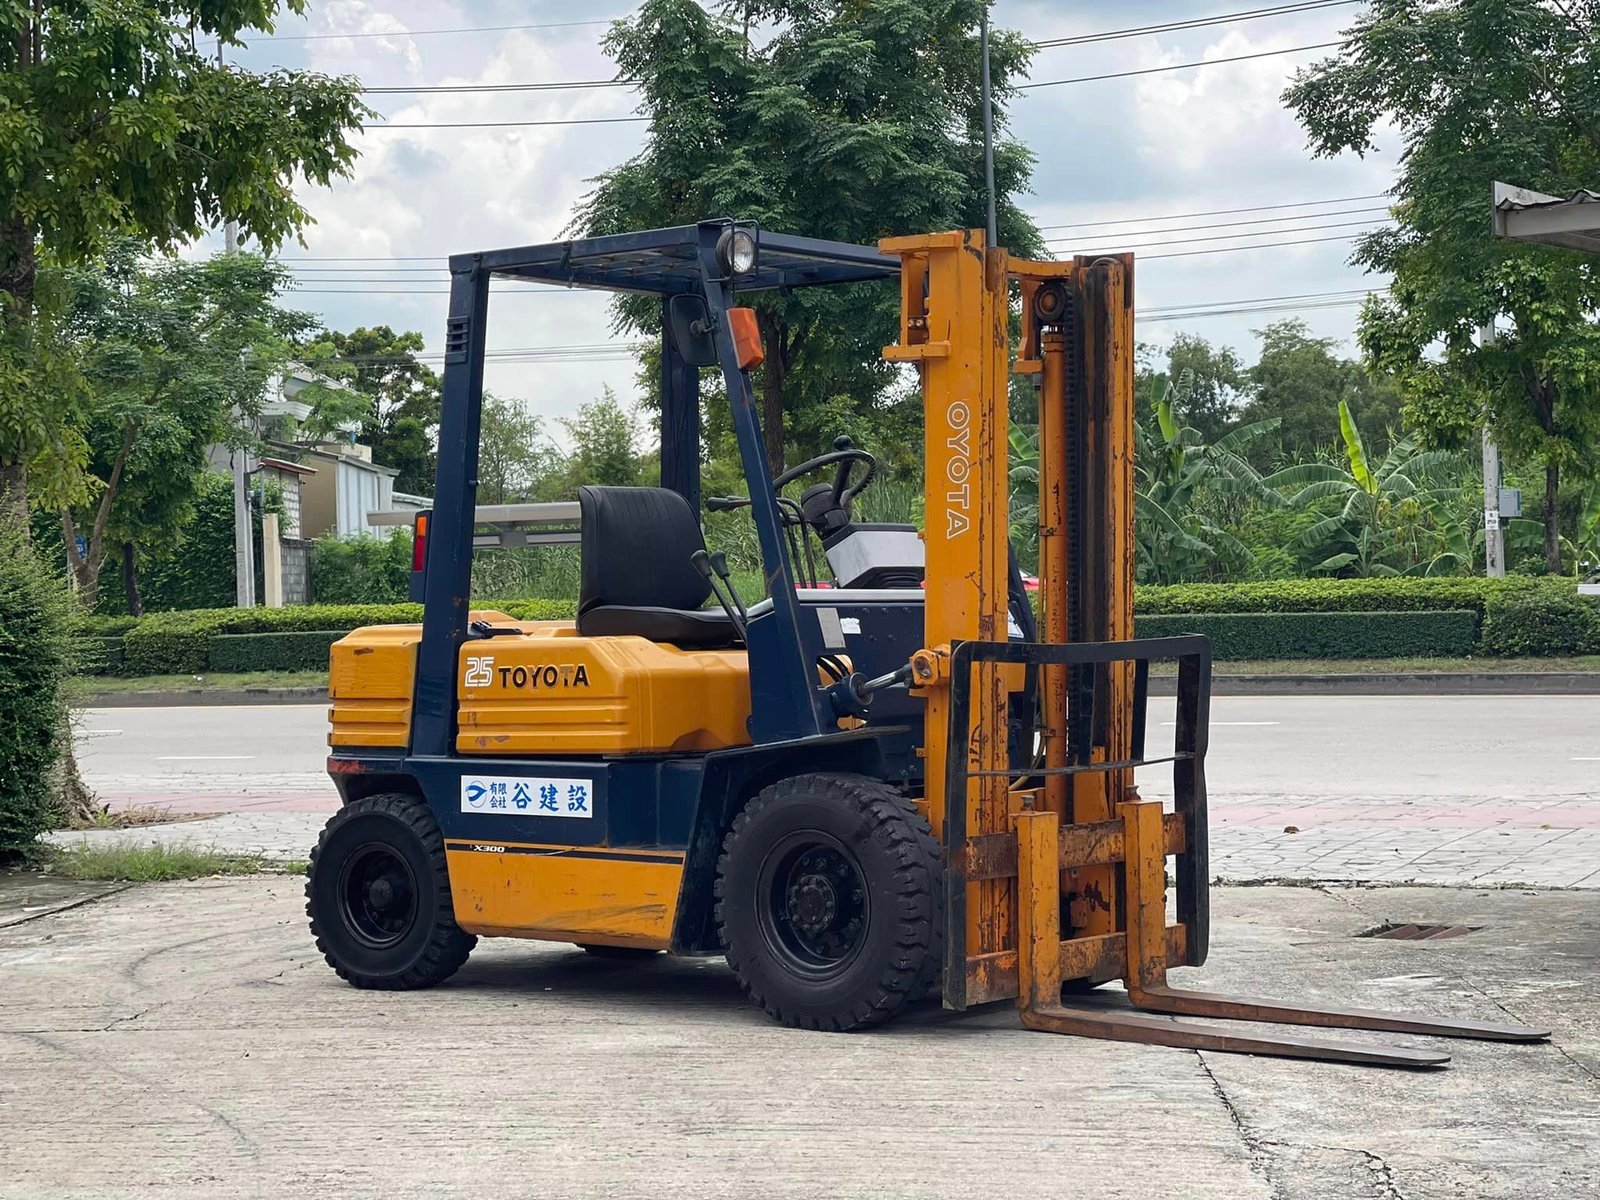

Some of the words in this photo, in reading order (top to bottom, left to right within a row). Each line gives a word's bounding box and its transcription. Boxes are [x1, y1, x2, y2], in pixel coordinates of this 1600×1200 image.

[464, 656, 495, 687] 25
[498, 664, 590, 689] TOYOTA
[489, 782, 508, 795] 有限
[489, 796, 507, 809] 会社
[511, 782, 588, 812] 谷建設
[473, 844, 506, 853] X300
